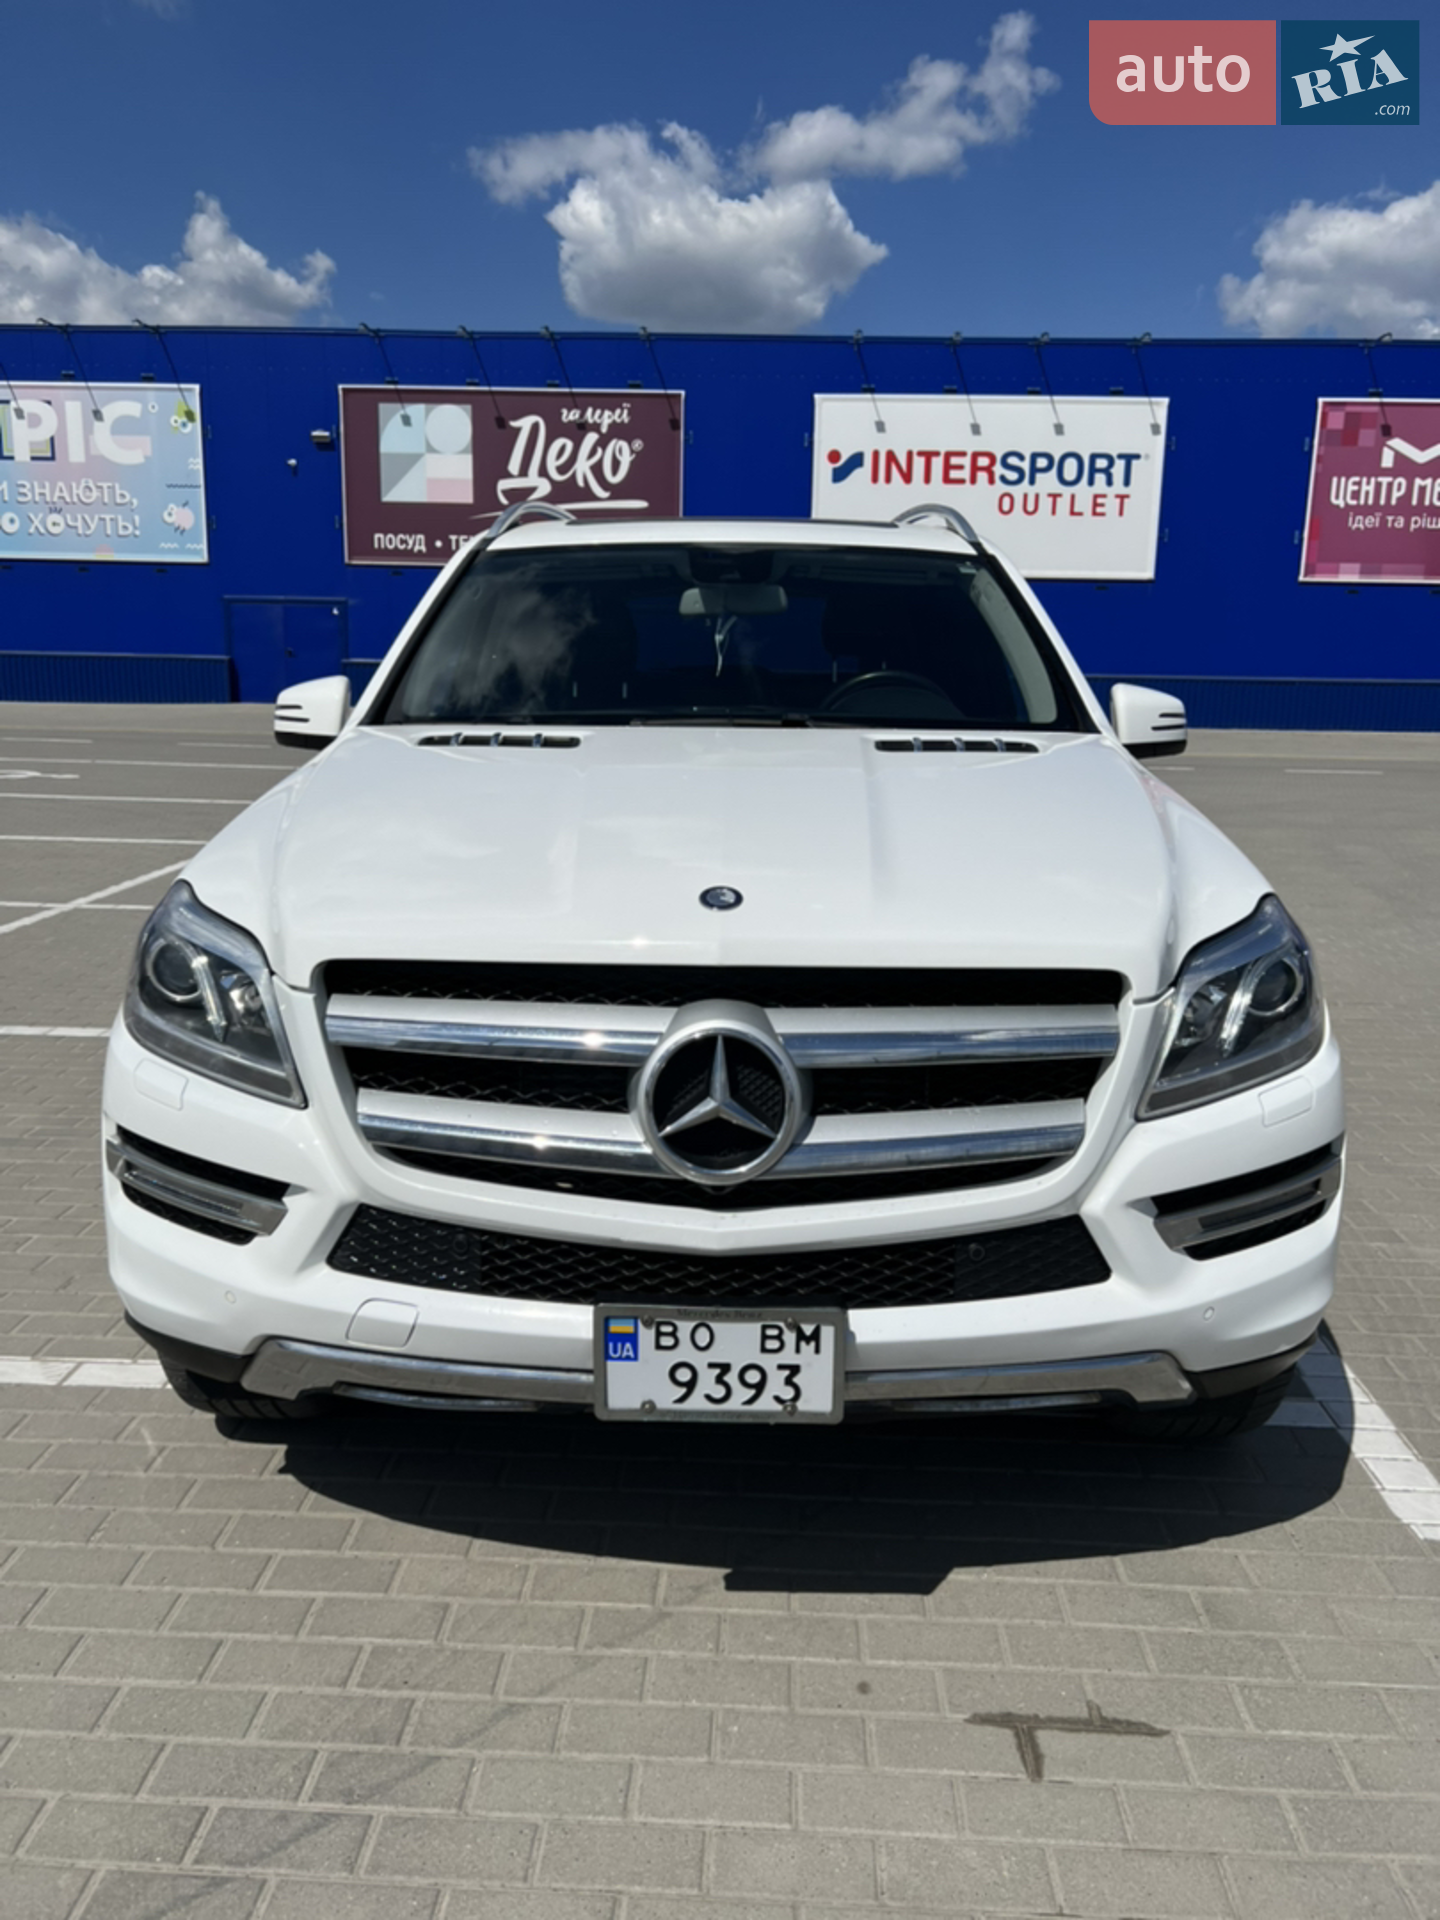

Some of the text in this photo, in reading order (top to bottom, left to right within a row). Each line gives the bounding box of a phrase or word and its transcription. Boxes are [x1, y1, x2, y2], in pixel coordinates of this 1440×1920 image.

[560, 402, 632, 434] галереї
[870, 448, 1142, 488] INTERSPORT
[16, 478, 139, 510] ЗНАЮТЬ,
[997, 492, 1131, 518] OUTLET
[1329, 475, 1407, 509] ЦЕНТР
[27, 512, 142, 538] ХОЧУТЬ!
[1348, 512, 1383, 531] ідеї
[1386, 515, 1405, 530] та
[373, 532, 427, 554] ПОСУД
[608, 1341, 635, 1359] UA
[668, 1361, 802, 1406] 9393
